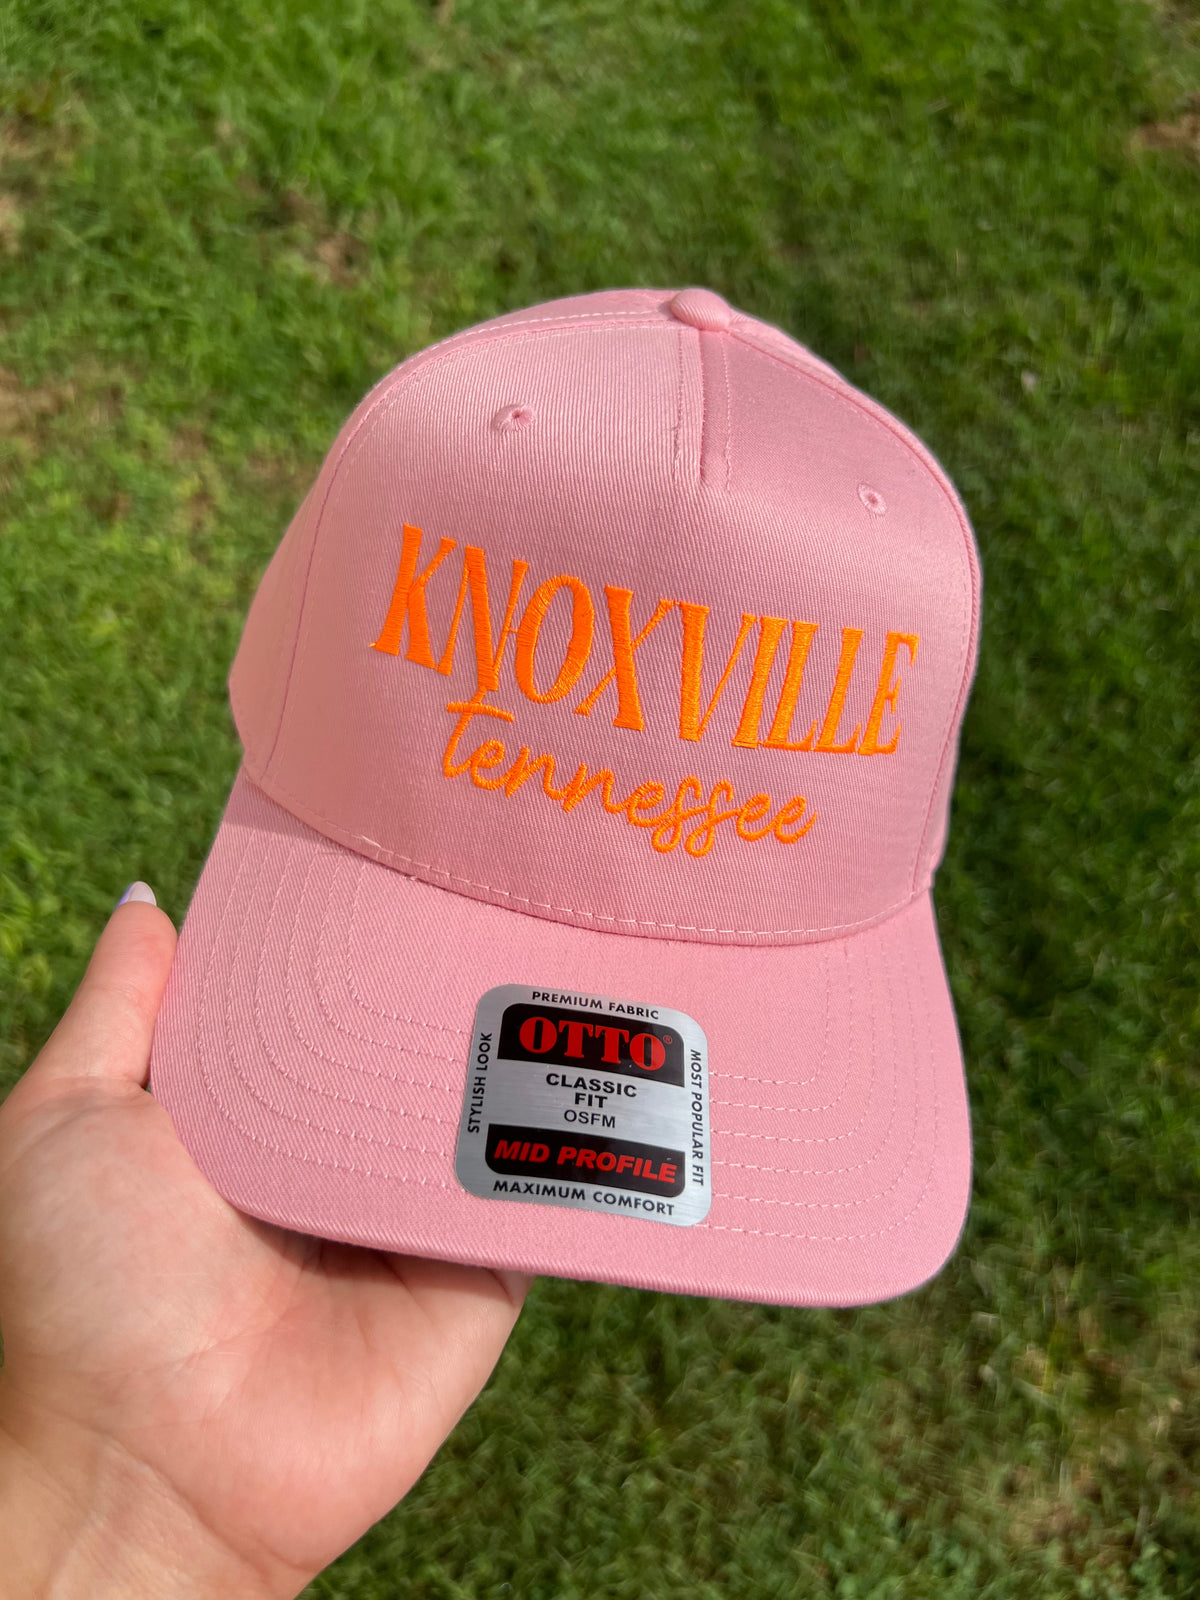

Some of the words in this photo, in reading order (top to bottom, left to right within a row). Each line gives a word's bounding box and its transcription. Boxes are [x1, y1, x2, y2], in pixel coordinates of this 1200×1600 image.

[370, 523, 919, 755] KNOXVILLE
[531, 991, 603, 1010] PREMIUM
[608, 1002, 659, 1020] FABRIC
[467, 1076, 487, 1134] STYLISH
[480, 1032, 493, 1072] LOOK
[545, 1072, 637, 1097] CLASSIC
[690, 1049, 703, 1089] MOST
[574, 1092, 608, 1108] FIT
[563, 1109, 616, 1129] OSFM
[691, 1092, 703, 1160] POPULAR
[494, 1140, 551, 1163] MID
[556, 1147, 678, 1184] PROFILE
[692, 1163, 704, 1186] FIT
[493, 1180, 586, 1201] MAXIMUM
[593, 1191, 675, 1216] COMFORT
